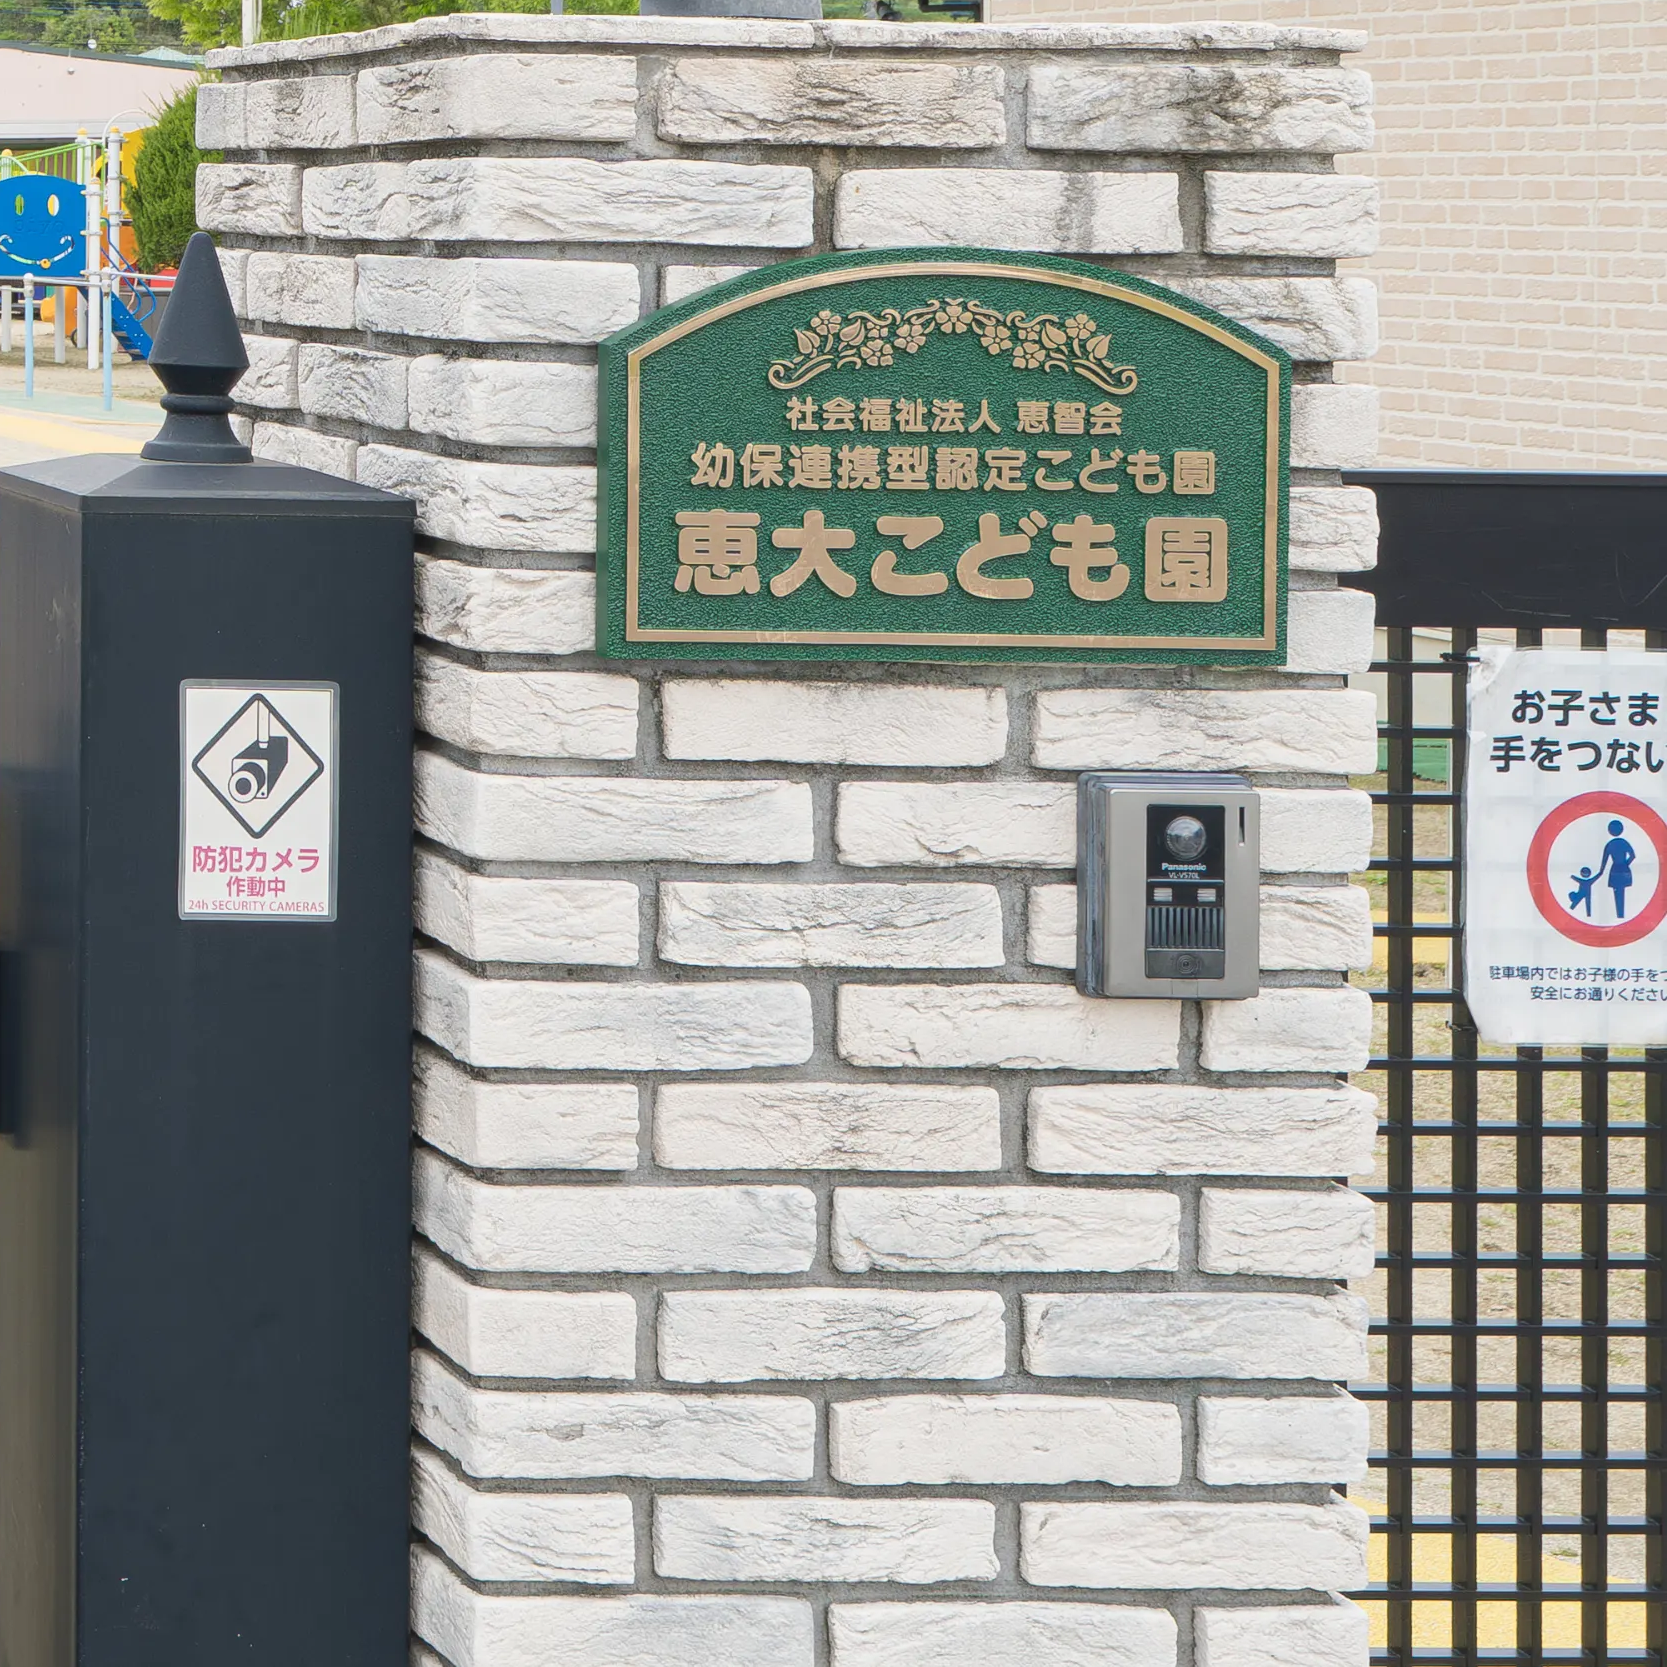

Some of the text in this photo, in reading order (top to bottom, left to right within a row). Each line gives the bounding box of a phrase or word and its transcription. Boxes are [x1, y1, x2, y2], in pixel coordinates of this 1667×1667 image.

[786, 396, 1123, 436] 社会福祉法人 恵智会
[690, 441, 1216, 495] 幼保連携型認定こども園
[674, 508, 1229, 603] 恵大こども園
[1512, 689, 1660, 727] お子さま
[192, 845, 320, 873] 防犯カメラ
[1161, 862, 1207, 871] Panasonic
[226, 875, 286, 898] 作動中
[188, 899, 325, 913] 24h SECURITY CAMERAS
